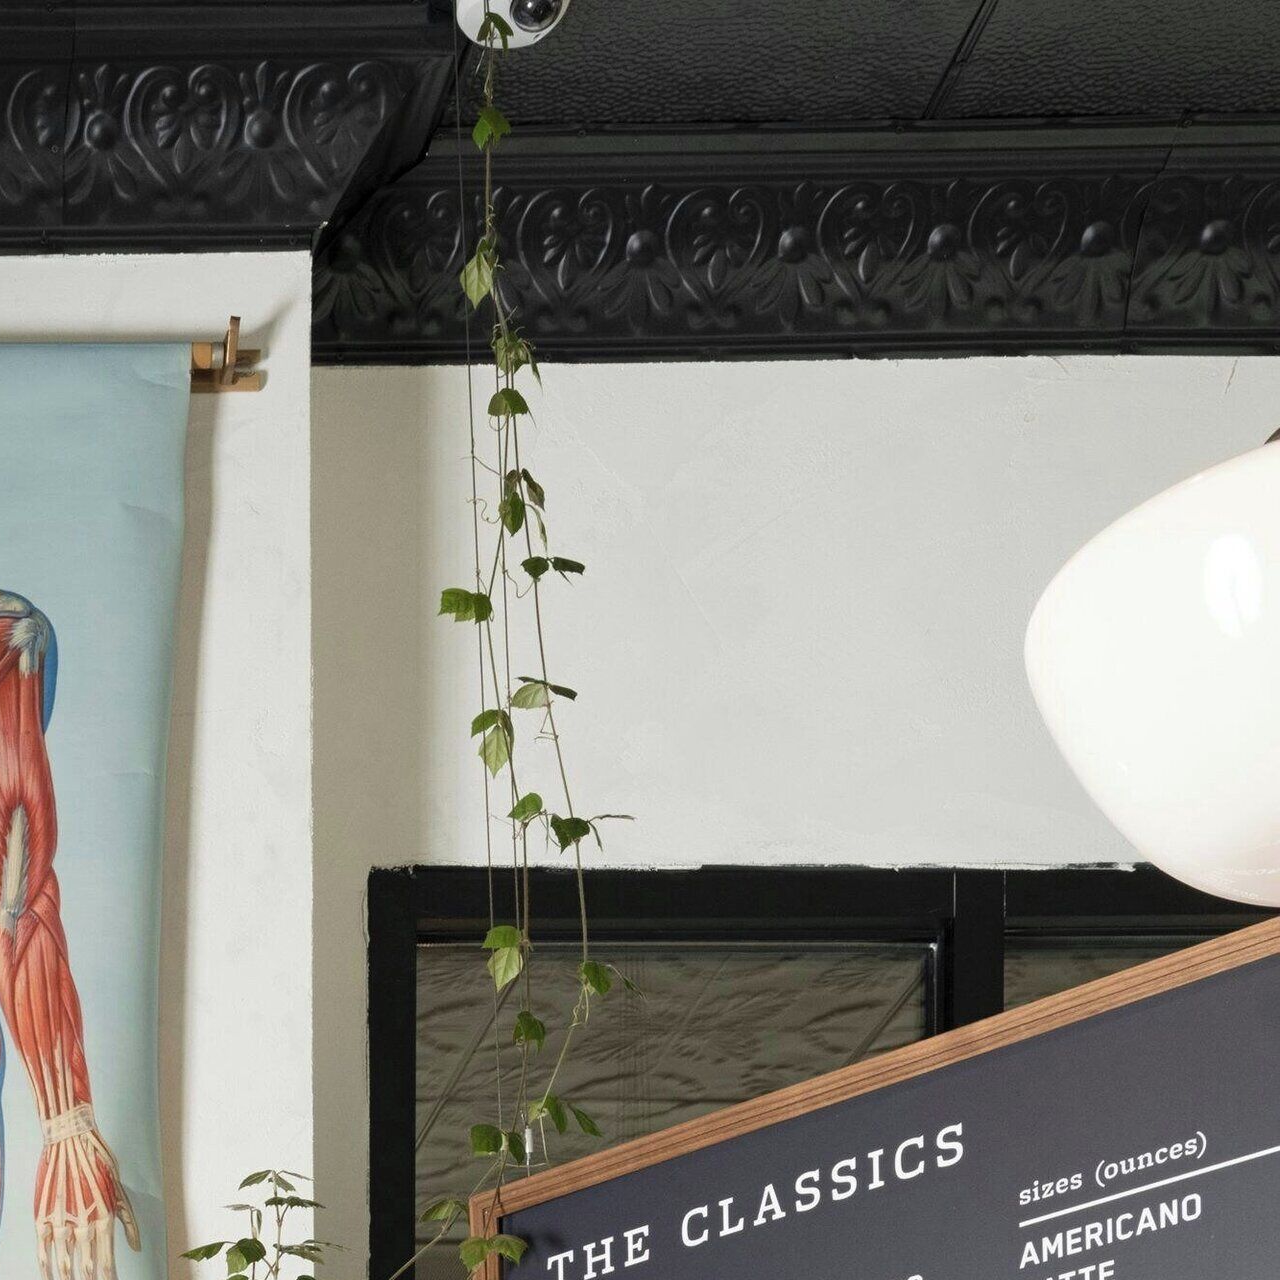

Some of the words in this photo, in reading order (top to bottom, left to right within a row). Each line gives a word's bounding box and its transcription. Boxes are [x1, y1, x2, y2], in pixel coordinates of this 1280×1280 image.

[680, 1122, 967, 1249] CLASSICS
[1020, 1173, 1082, 1205] sizes
[1096, 1131, 1206, 1187] (ounces)
[1020, 1189, 1201, 1269] AMERICANO
